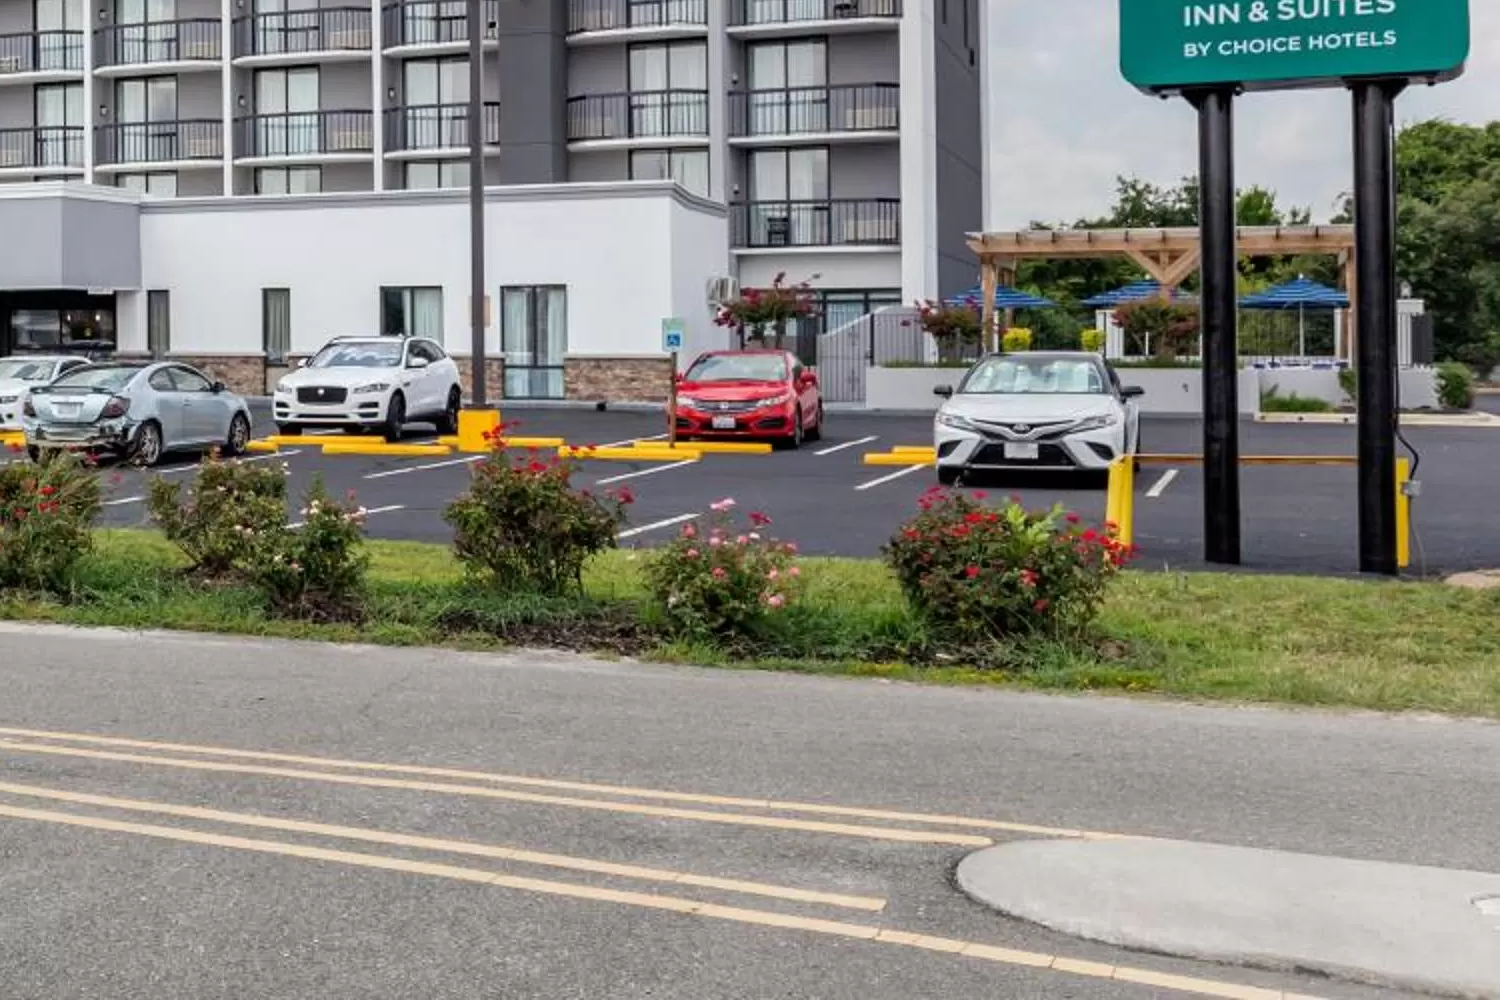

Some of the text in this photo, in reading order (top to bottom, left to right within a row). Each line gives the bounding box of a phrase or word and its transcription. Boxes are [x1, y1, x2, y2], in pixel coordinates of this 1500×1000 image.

[1183, 3, 1240, 26] INN
[1248, 1, 1269, 23] &
[1184, 30, 1396, 57] BY CHOICE HOTELS
